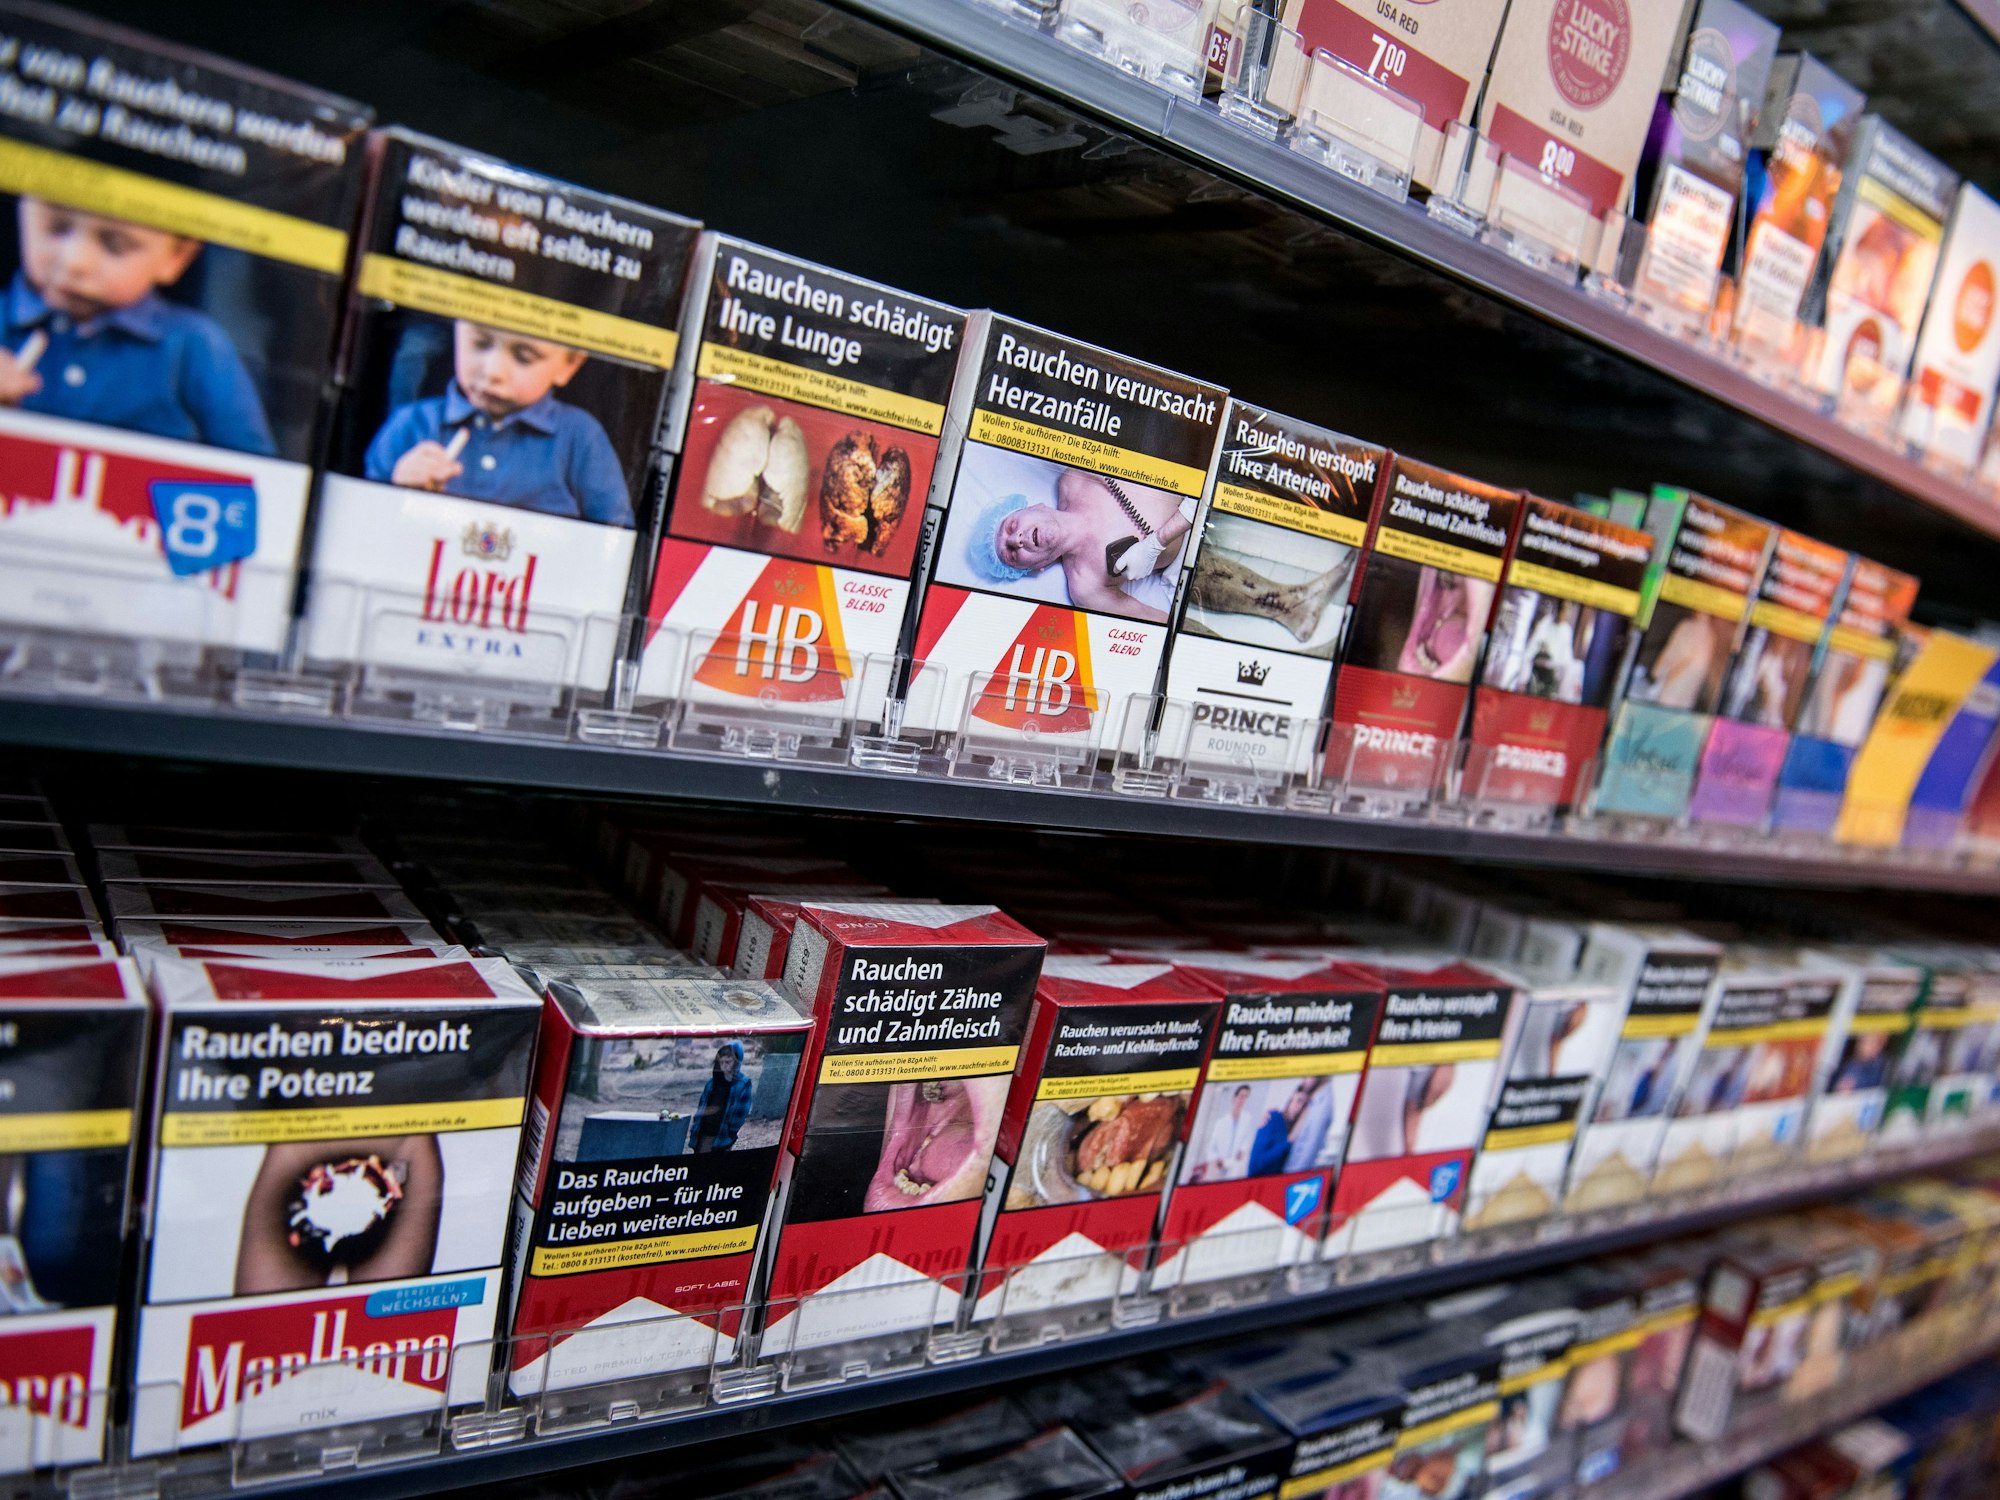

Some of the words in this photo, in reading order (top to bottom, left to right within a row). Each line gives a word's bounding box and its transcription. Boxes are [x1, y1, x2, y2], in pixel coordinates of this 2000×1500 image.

[1376, 1, 1397, 24] USA
[1398, 14, 1420, 35] RED
[1570, 0, 1620, 50] LUCKY
[1560, 23, 1614, 78] STRIKE
[407, 154, 493, 205] Kinder
[497, 184, 543, 220] von
[545, 195, 654, 250] Rauchern
[395, 224, 516, 282] Rauchern
[401, 195, 500, 243] werden
[501, 219, 541, 252] oft
[542, 234, 613, 273] selbst
[612, 255, 643, 281] zu
[727, 256, 844, 318] Rauchen
[849, 299, 955, 354] schädigt
[719, 297, 777, 342] Ihre
[781, 314, 863, 367] Lunge
[997, 334, 1100, 390] Rauchen
[1104, 372, 1217, 426] verursacht
[845, 401, 934, 431] www.rauchfrei-info.de
[987, 374, 1122, 438] Herzanfälle
[982, 413, 1011, 430] Wollen
[1013, 420, 1025, 434] Sie
[1026, 423, 1066, 445] aufhören?
[1067, 436, 1081, 449] Die
[1082, 440, 1101, 456] BZgA
[1103, 444, 1121, 460] hilft:
[1236, 420, 1305, 461] Rauchen
[1309, 446, 1377, 484] verstopft
[978, 428, 996, 443] Tel.:
[996, 433, 1050, 456] 08008313131
[1051, 449, 1098, 471] (kostenfrei),
[1099, 461, 1179, 490] www.rauchfrei-info.de
[1229, 450, 1262, 481] Ihre
[1265, 463, 1331, 500] Arterien
[1395, 473, 1444, 505] Rauchen
[1444, 490, 1490, 520] schädigt
[1389, 497, 1427, 525] Zähne
[1426, 511, 1451, 531] und
[1448, 514, 1507, 547] Zahnfleisch
[422, 538, 538, 634] Lord
[843, 581, 893, 600] CLASSIC
[845, 599, 886, 614] BLEND
[416, 629, 523, 658] EXTRA
[735, 599, 824, 684] HB
[1107, 628, 1148, 644] CLASSIC
[1108, 643, 1141, 657] BLEND
[1004, 643, 1076, 717] HB
[1194, 704, 1292, 739] PRINCE
[1207, 737, 1267, 757] ROUNDED
[1352, 722, 1438, 758] PRINCE
[836, 920, 891, 931] LONG
[851, 957, 944, 982] Rauchen
[843, 989, 938, 1016] schädigt
[939, 987, 1003, 1011] Zähne
[1226, 996, 1293, 1026] Rauchen
[1294, 1000, 1353, 1024] mindert
[182, 1022, 333, 1061] Rauchen
[341, 1021, 473, 1057] bedroht
[837, 1020, 884, 1046] und
[884, 1016, 1001, 1043] Zahnfleisch
[1054, 1042, 1101, 1058] Rachen-
[1102, 1041, 1124, 1056] und
[1125, 1037, 1199, 1057] Kehlkopfkrebs
[1060, 1024, 1109, 1040] Rauchen
[1110, 1021, 1166, 1038] verursacht
[1219, 1029, 1252, 1053] Ihre
[1254, 1026, 1352, 1050] Fruchtbarkeit
[829, 1069, 844, 1078] Tel.:
[845, 1068, 864, 1077] 0800
[865, 1068, 871, 1076] 8
[871, 1067, 896, 1076] 313131
[896, 1063, 938, 1075] (kostenfrei),
[938, 1057, 1010, 1072] www.rauchfrei-info.de
[831, 1059, 854, 1067] Wollen
[864, 1056, 895, 1067] aufhören?
[896, 1056, 907, 1065] Die
[907, 1055, 923, 1066] BZgA
[177, 1067, 250, 1102] Ihre
[258, 1065, 375, 1099] Potenz
[557, 1170, 599, 1191] Das
[603, 1164, 689, 1189] Rauchen
[552, 1193, 652, 1219] aufgeben
[673, 1186, 703, 1207] für
[705, 1182, 744, 1203] Ihre
[547, 1221, 618, 1243] Lieben
[622, 1209, 738, 1236] weiterleben
[542, 1260, 560, 1272] Tel.:
[560, 1258, 581, 1270] 0800
[582, 1258, 588, 1268] 8
[588, 1255, 617, 1267] 313131
[617, 1250, 663, 1265] (kostenfrei),
[665, 1238, 748, 1257] www.rauchfrei-info.de
[544, 1250, 570, 1261] Wollen
[571, 1249, 583, 1259] Sie
[583, 1245, 620, 1257] aufhören?
[621, 1243, 633, 1252] Die
[634, 1242, 655, 1253] BZgA
[655, 1240, 672, 1249] hilft:
[380, 1291, 469, 1313] WECHSELN?
[674, 1283, 704, 1294] SOFT
[707, 1279, 741, 1290] LABEL
[190, 1308, 450, 1416] Marlboro
[594, 1353, 655, 1371] PREMIUM
[301, 1406, 337, 1423] mix
